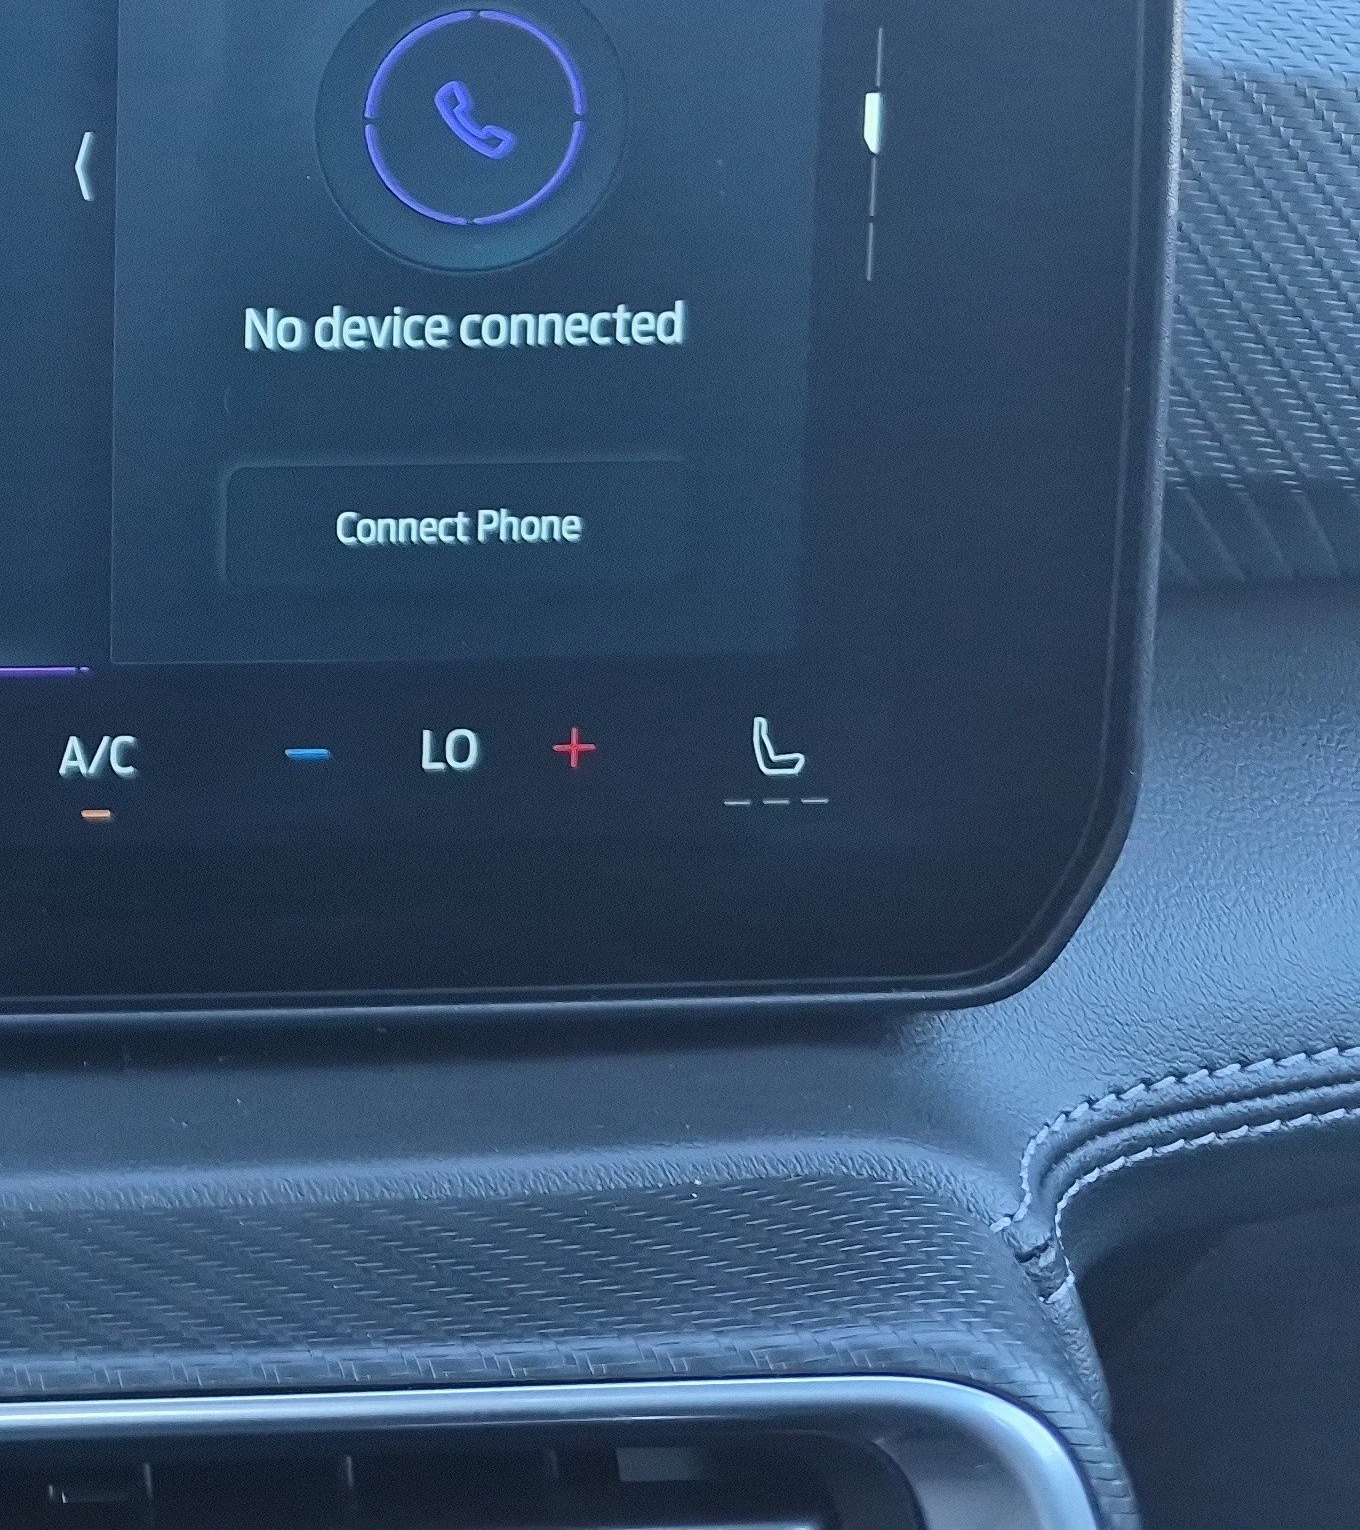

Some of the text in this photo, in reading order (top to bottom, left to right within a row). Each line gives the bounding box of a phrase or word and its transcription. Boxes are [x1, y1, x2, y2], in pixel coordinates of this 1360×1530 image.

[243, 299, 686, 351] No device connected
[335, 506, 584, 547] Connect Phone
[58, 734, 138, 778] A/C
[420, 728, 480, 773] LO
